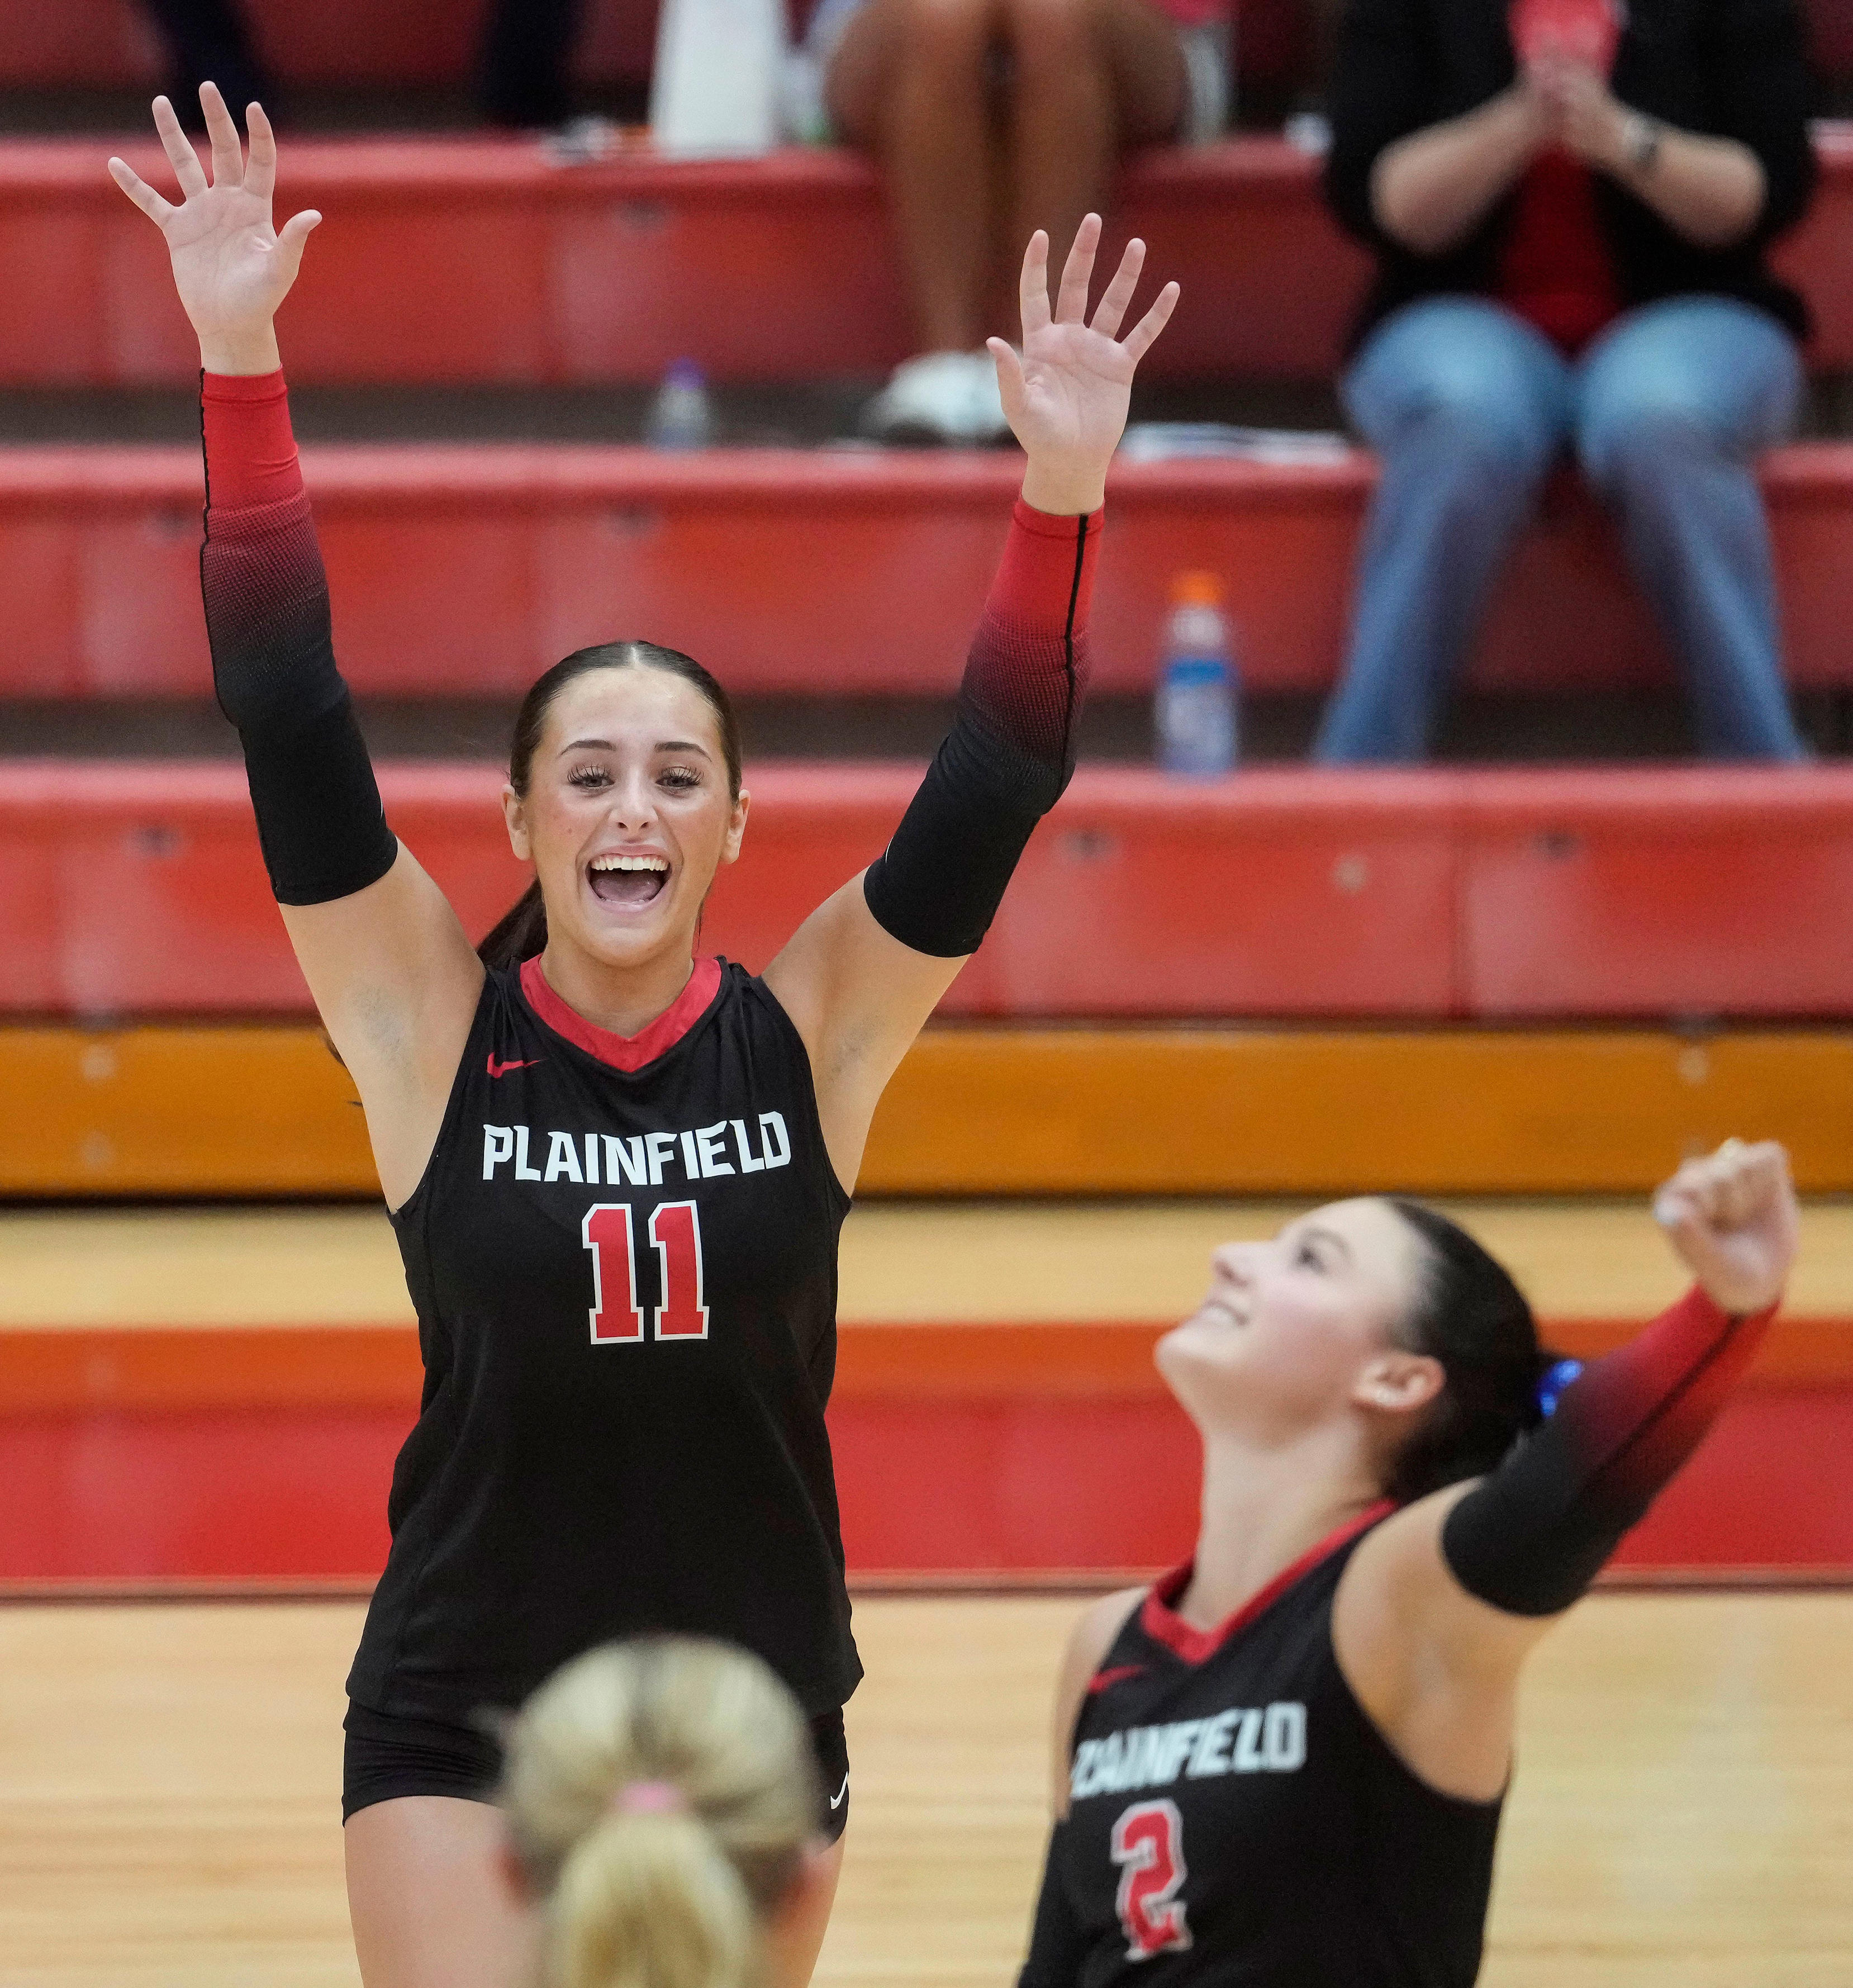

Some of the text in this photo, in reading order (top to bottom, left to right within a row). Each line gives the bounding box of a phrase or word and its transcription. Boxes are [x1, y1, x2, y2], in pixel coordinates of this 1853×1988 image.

[483, 1111, 791, 1185] PLAINFIELD
[581, 1199, 710, 1344] 11
[1071, 1702, 1307, 1798] LAINFIELD
[1111, 1799, 1193, 1961] 2
